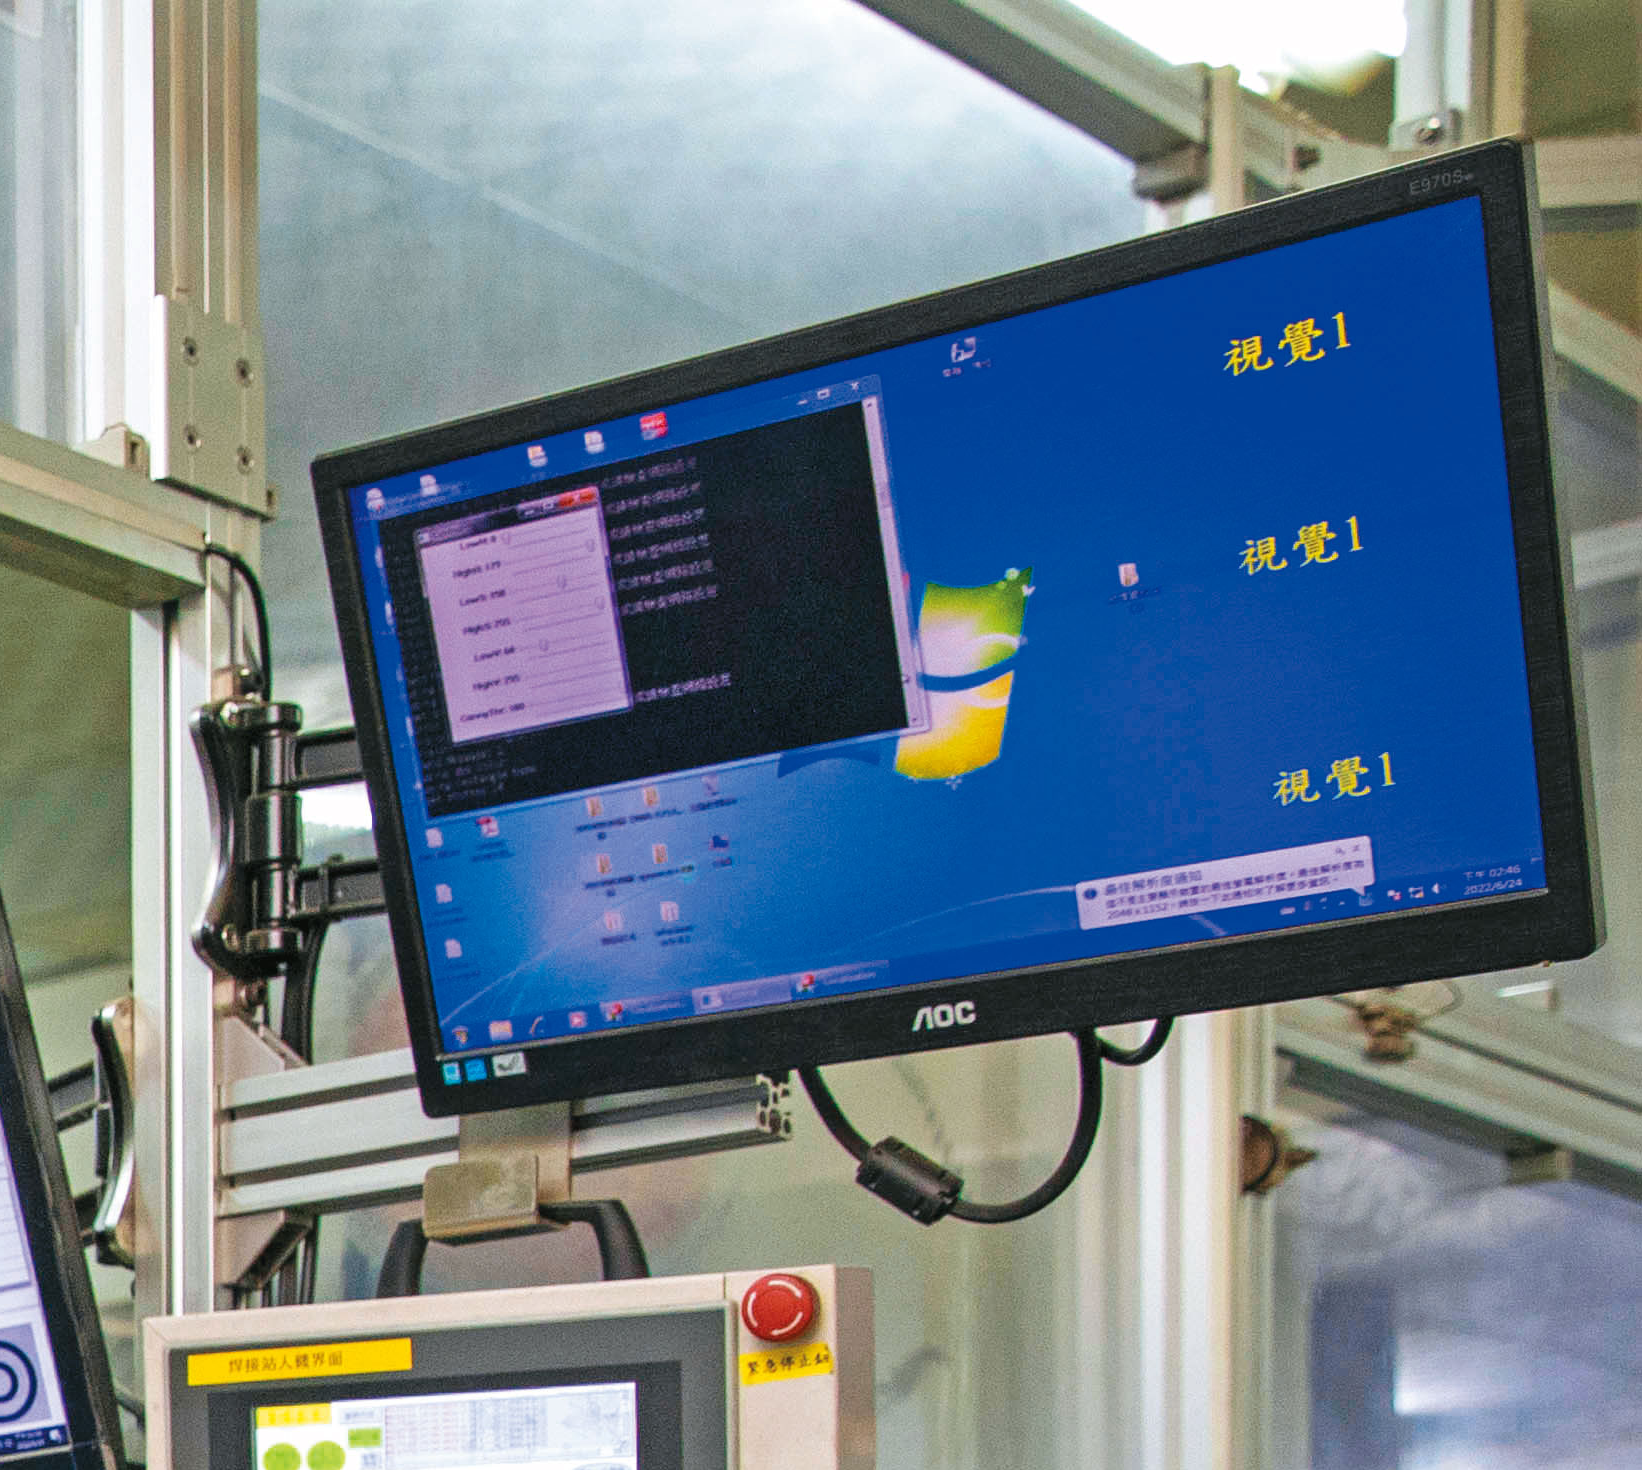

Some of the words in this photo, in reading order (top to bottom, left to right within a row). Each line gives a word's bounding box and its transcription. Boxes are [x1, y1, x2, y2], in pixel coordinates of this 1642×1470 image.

[1223, 311, 1352, 377] 視覺1
[1237, 515, 1365, 576] 視覺1
[1272, 751, 1397, 807] 視覺1
[912, 1000, 977, 1032] AOC
